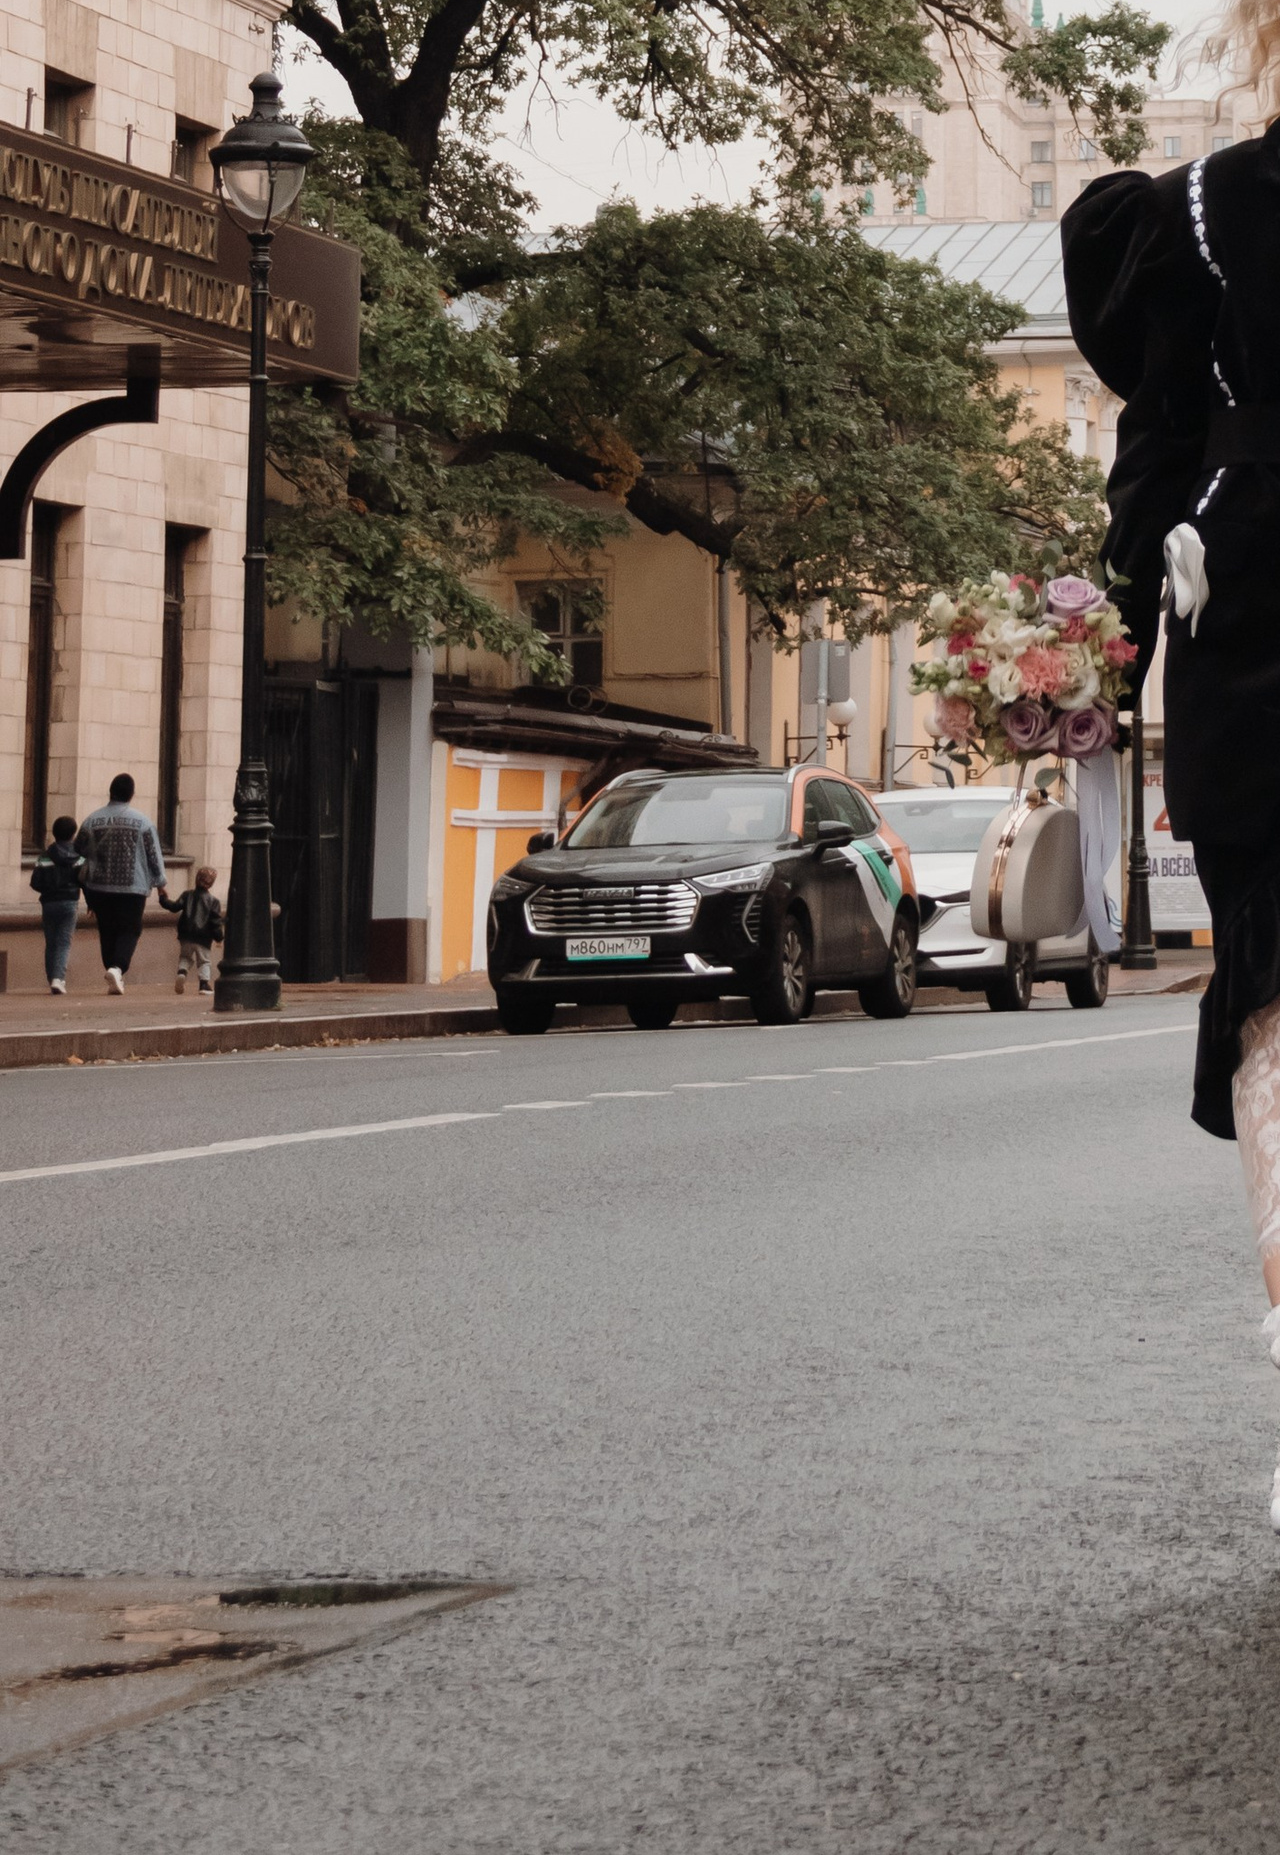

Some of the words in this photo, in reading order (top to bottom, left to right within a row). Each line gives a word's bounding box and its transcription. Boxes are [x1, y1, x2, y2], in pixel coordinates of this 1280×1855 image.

[70, 170, 219, 263] ПИСАТЕЛЕЙ
[79, 238, 157, 305] ДОМА
[91, 817, 106, 827] LOS
[107, 816, 143, 828] ANGELES
